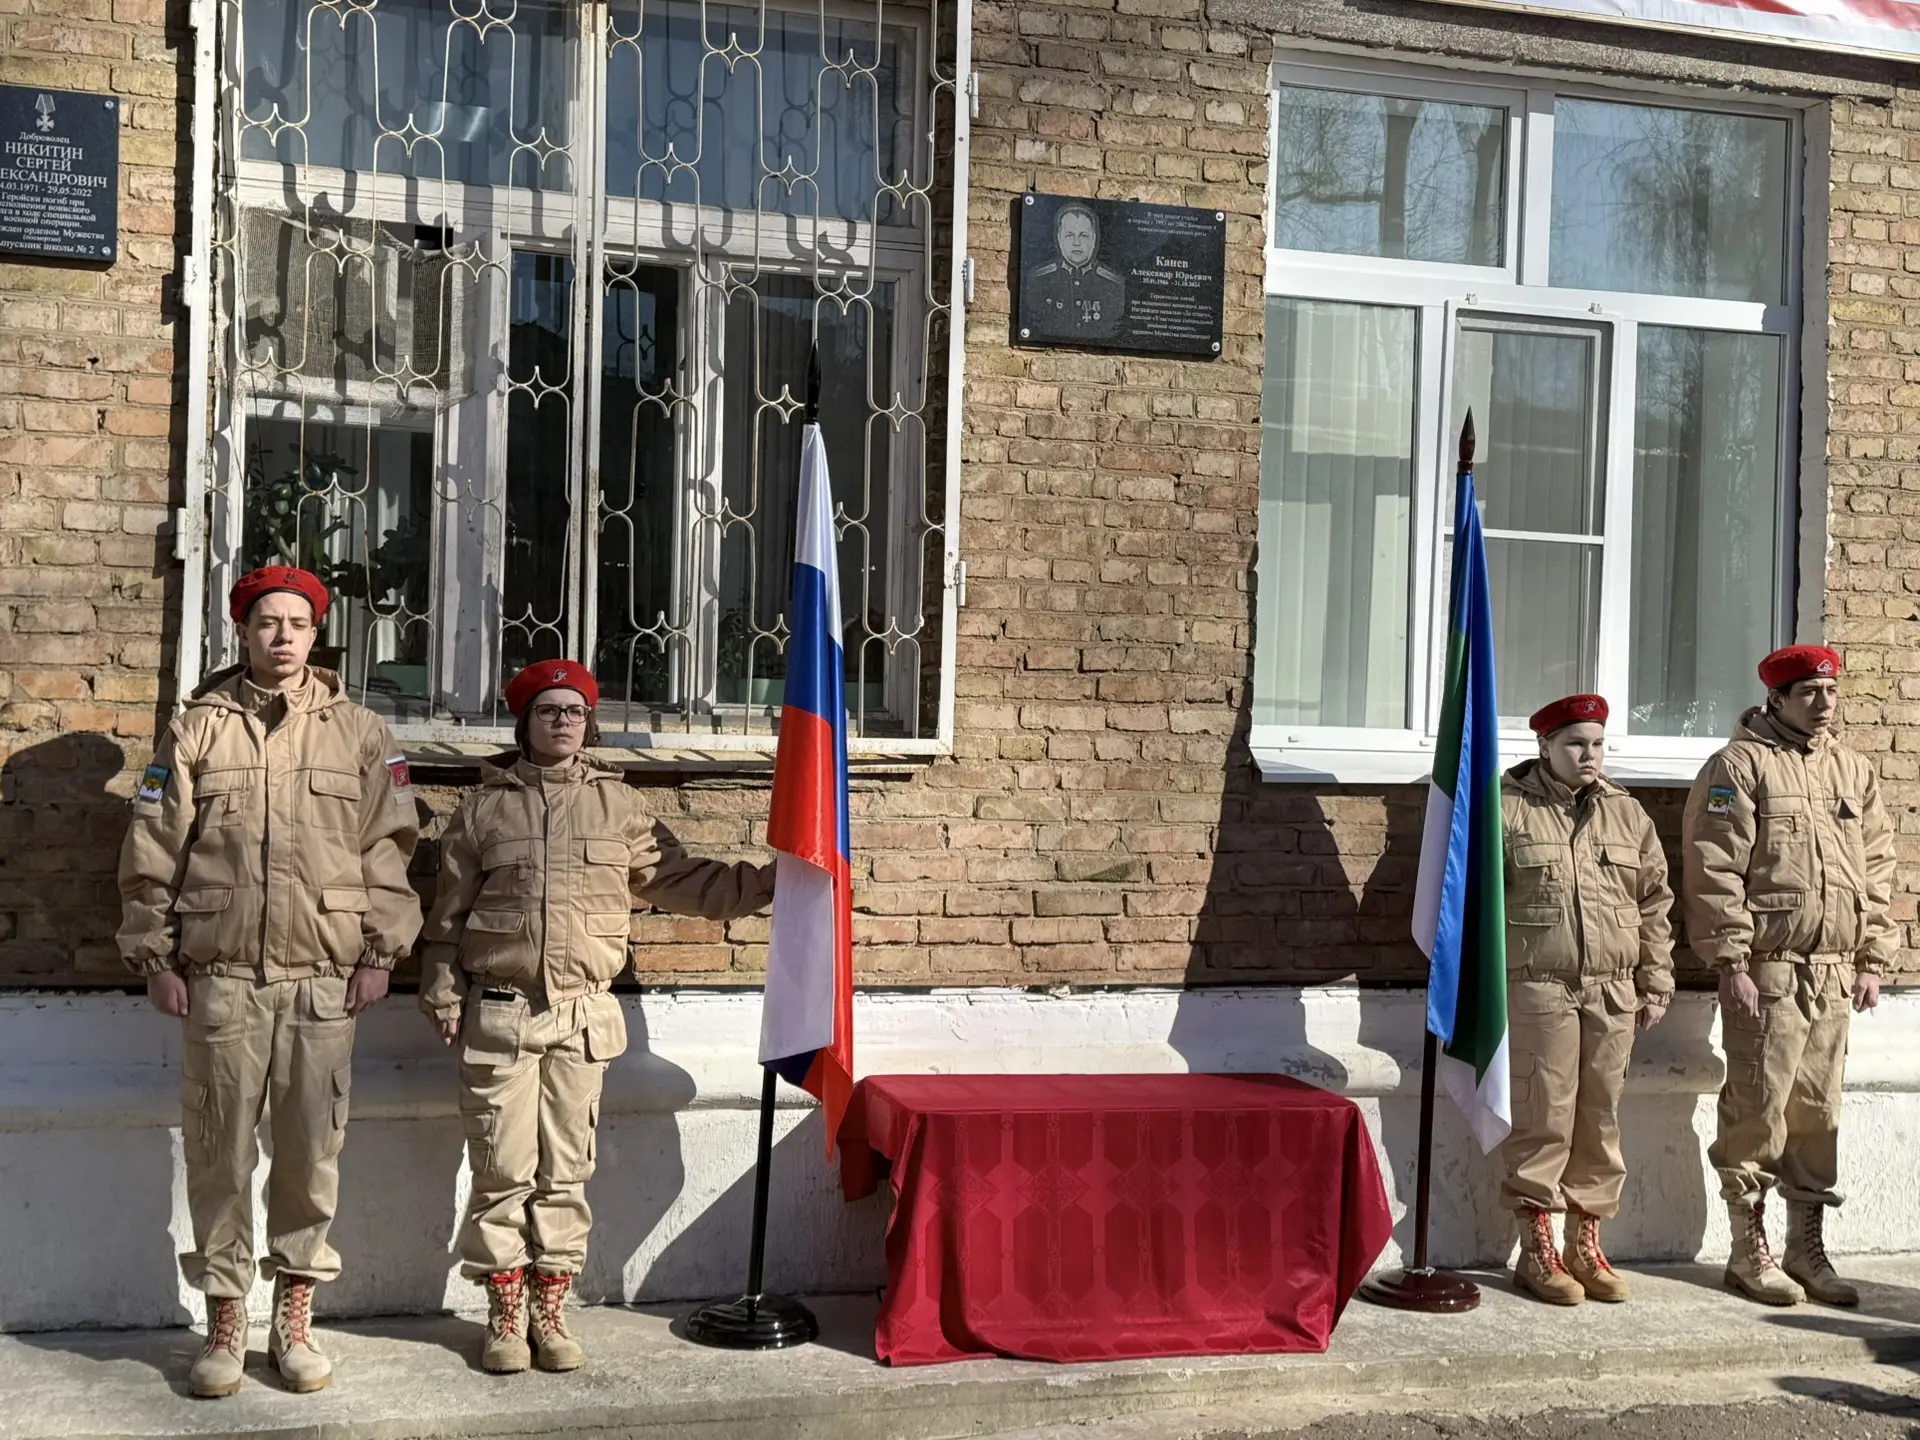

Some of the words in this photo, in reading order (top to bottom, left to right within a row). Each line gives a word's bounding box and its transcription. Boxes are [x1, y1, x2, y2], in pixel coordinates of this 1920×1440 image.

[19, 131, 70, 144] Доброволец
[5, 141, 83, 160] НИКИТИН
[16, 156, 72, 172] СЕРГЕЙ
[47, 185, 92, 197] 29.05.2022
[2, 192, 41, 203] Геройски
[42, 197, 68, 205] погиб
[69, 199, 85, 207] при
[48, 205, 90, 214] воинского
[4, 216, 39, 224] военной
[42, 212, 96, 222] специальной
[24, 227, 60, 236] орденом
[63, 229, 105, 240] Мужества
[43, 243, 74, 252] школы
[76, 245, 87, 254] №
[89, 245, 95, 254] 2
[1156, 256, 1189, 268] Канев
[1131, 267, 1173, 280] Александр
[1175, 271, 1212, 282] Юрьевич
